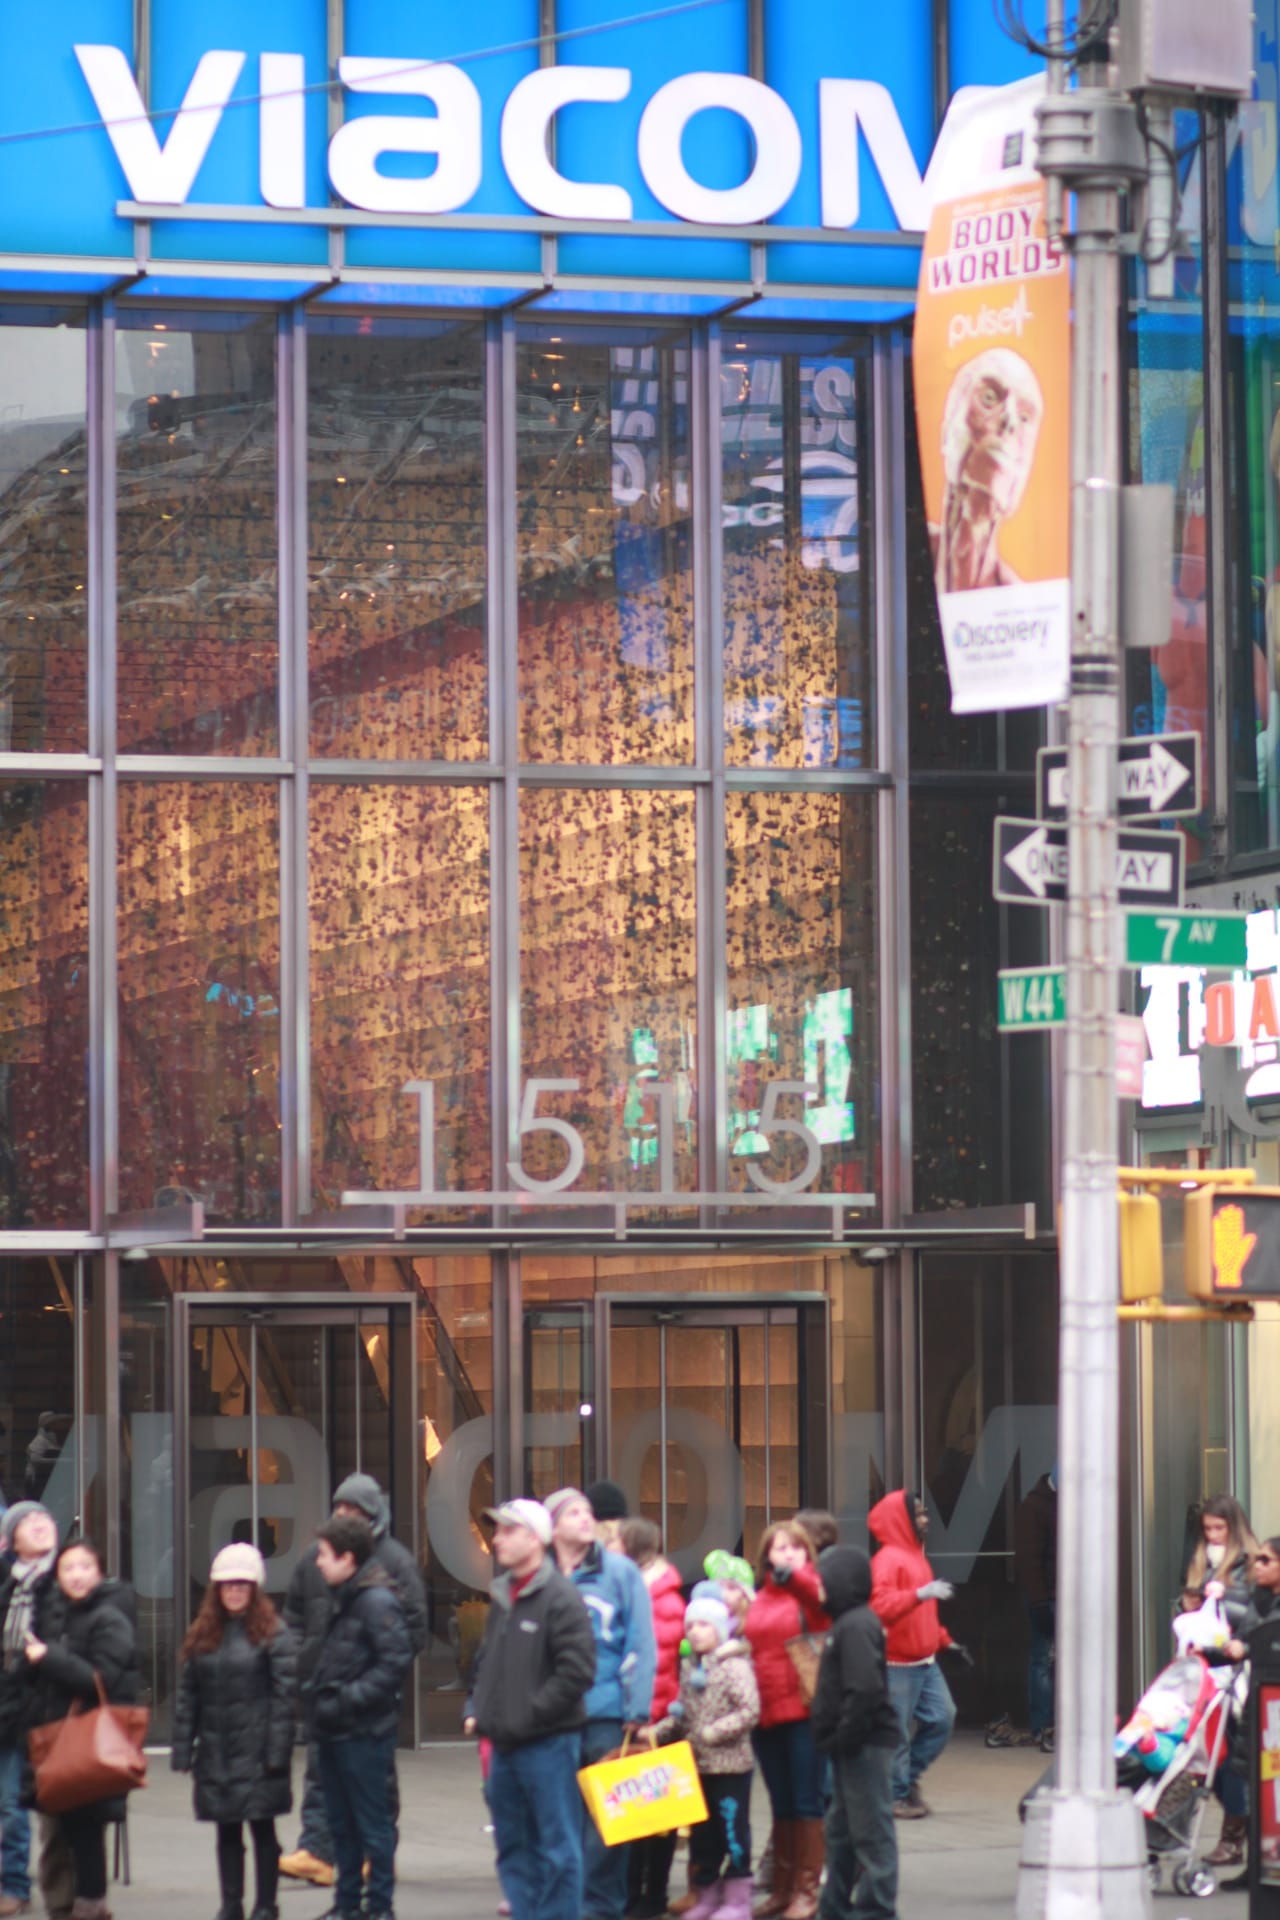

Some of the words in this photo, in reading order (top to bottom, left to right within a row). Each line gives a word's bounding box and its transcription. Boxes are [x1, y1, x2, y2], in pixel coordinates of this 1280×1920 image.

[954, 208, 1034, 250] BODY
[932, 236, 1062, 289] WORLDS
[1125, 763, 1171, 792] WAY
[1115, 855, 1158, 883] AY
[1155, 917, 1182, 963] 7
